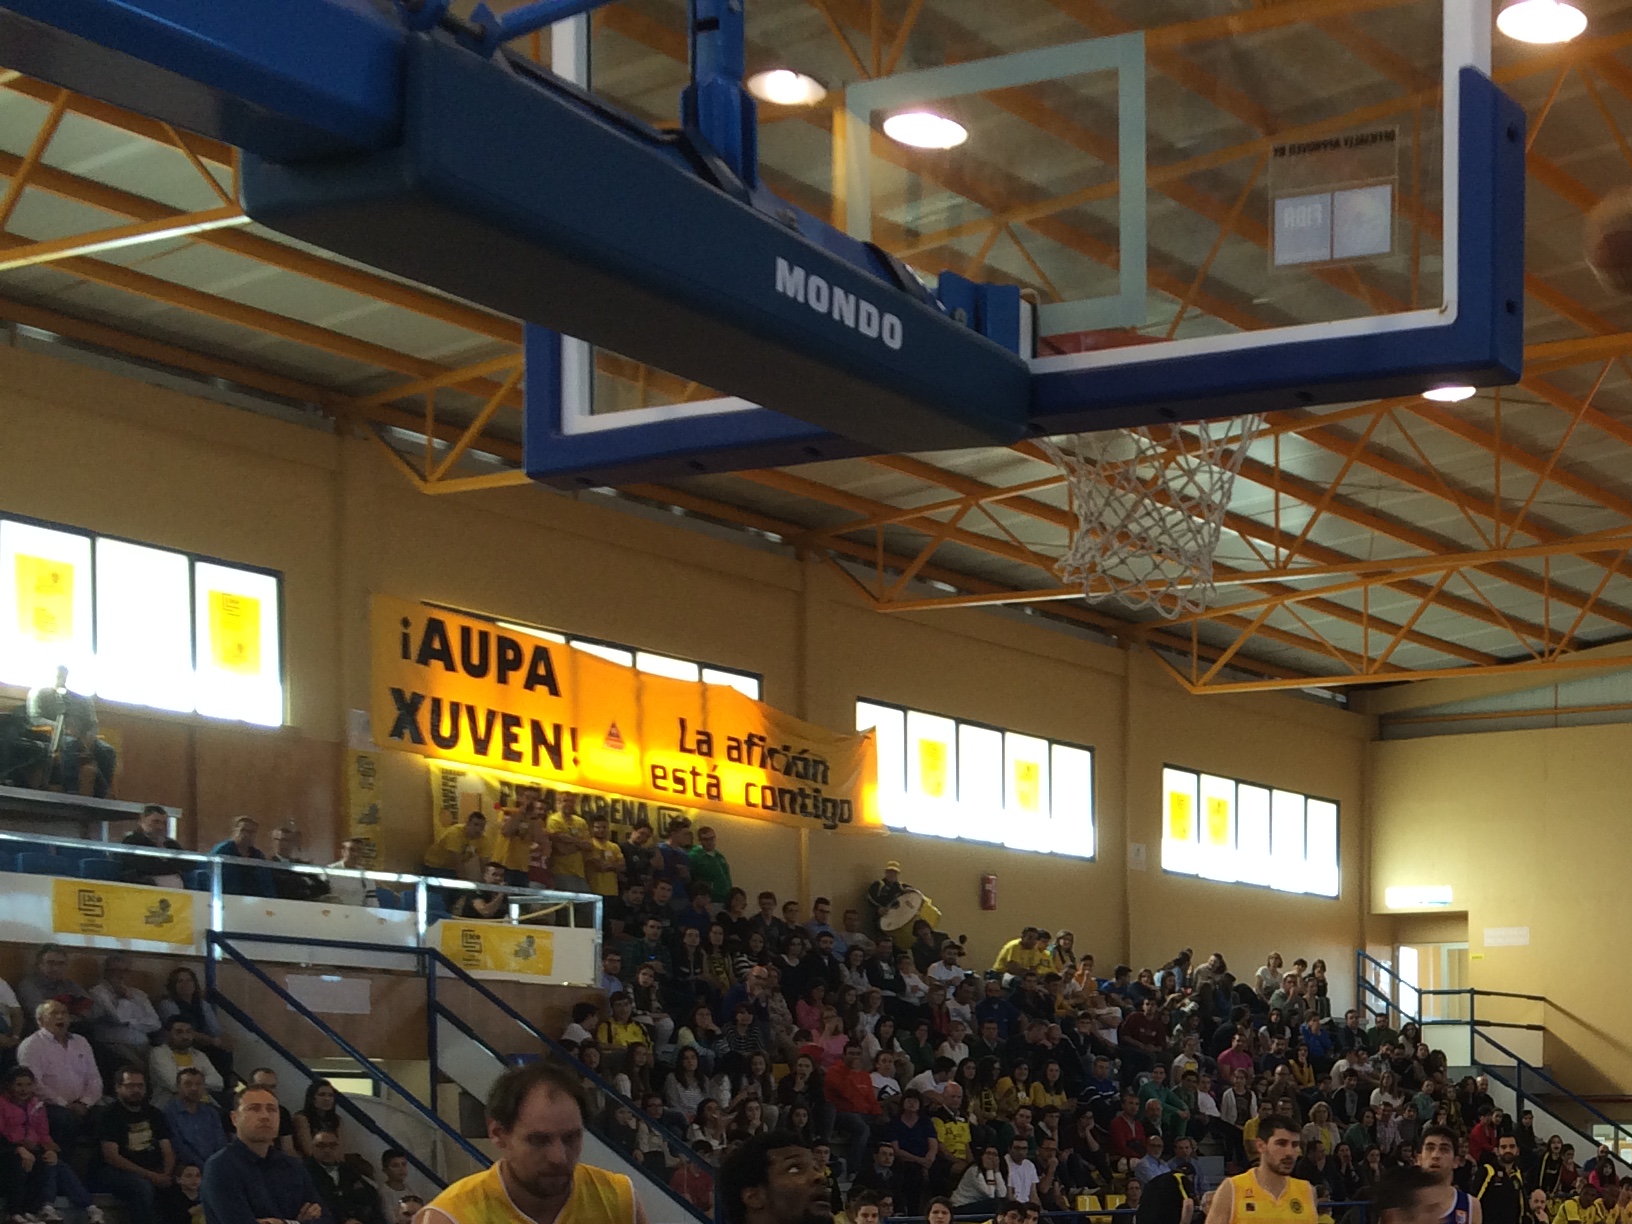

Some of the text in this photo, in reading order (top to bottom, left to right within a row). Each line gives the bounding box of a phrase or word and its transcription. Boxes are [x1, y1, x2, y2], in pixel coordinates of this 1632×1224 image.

[774, 256, 903, 351] MONDO
[389, 686, 580, 771] XUVEN!
[678, 717, 830, 785] La afición
[651, 764, 853, 830] está contigo
